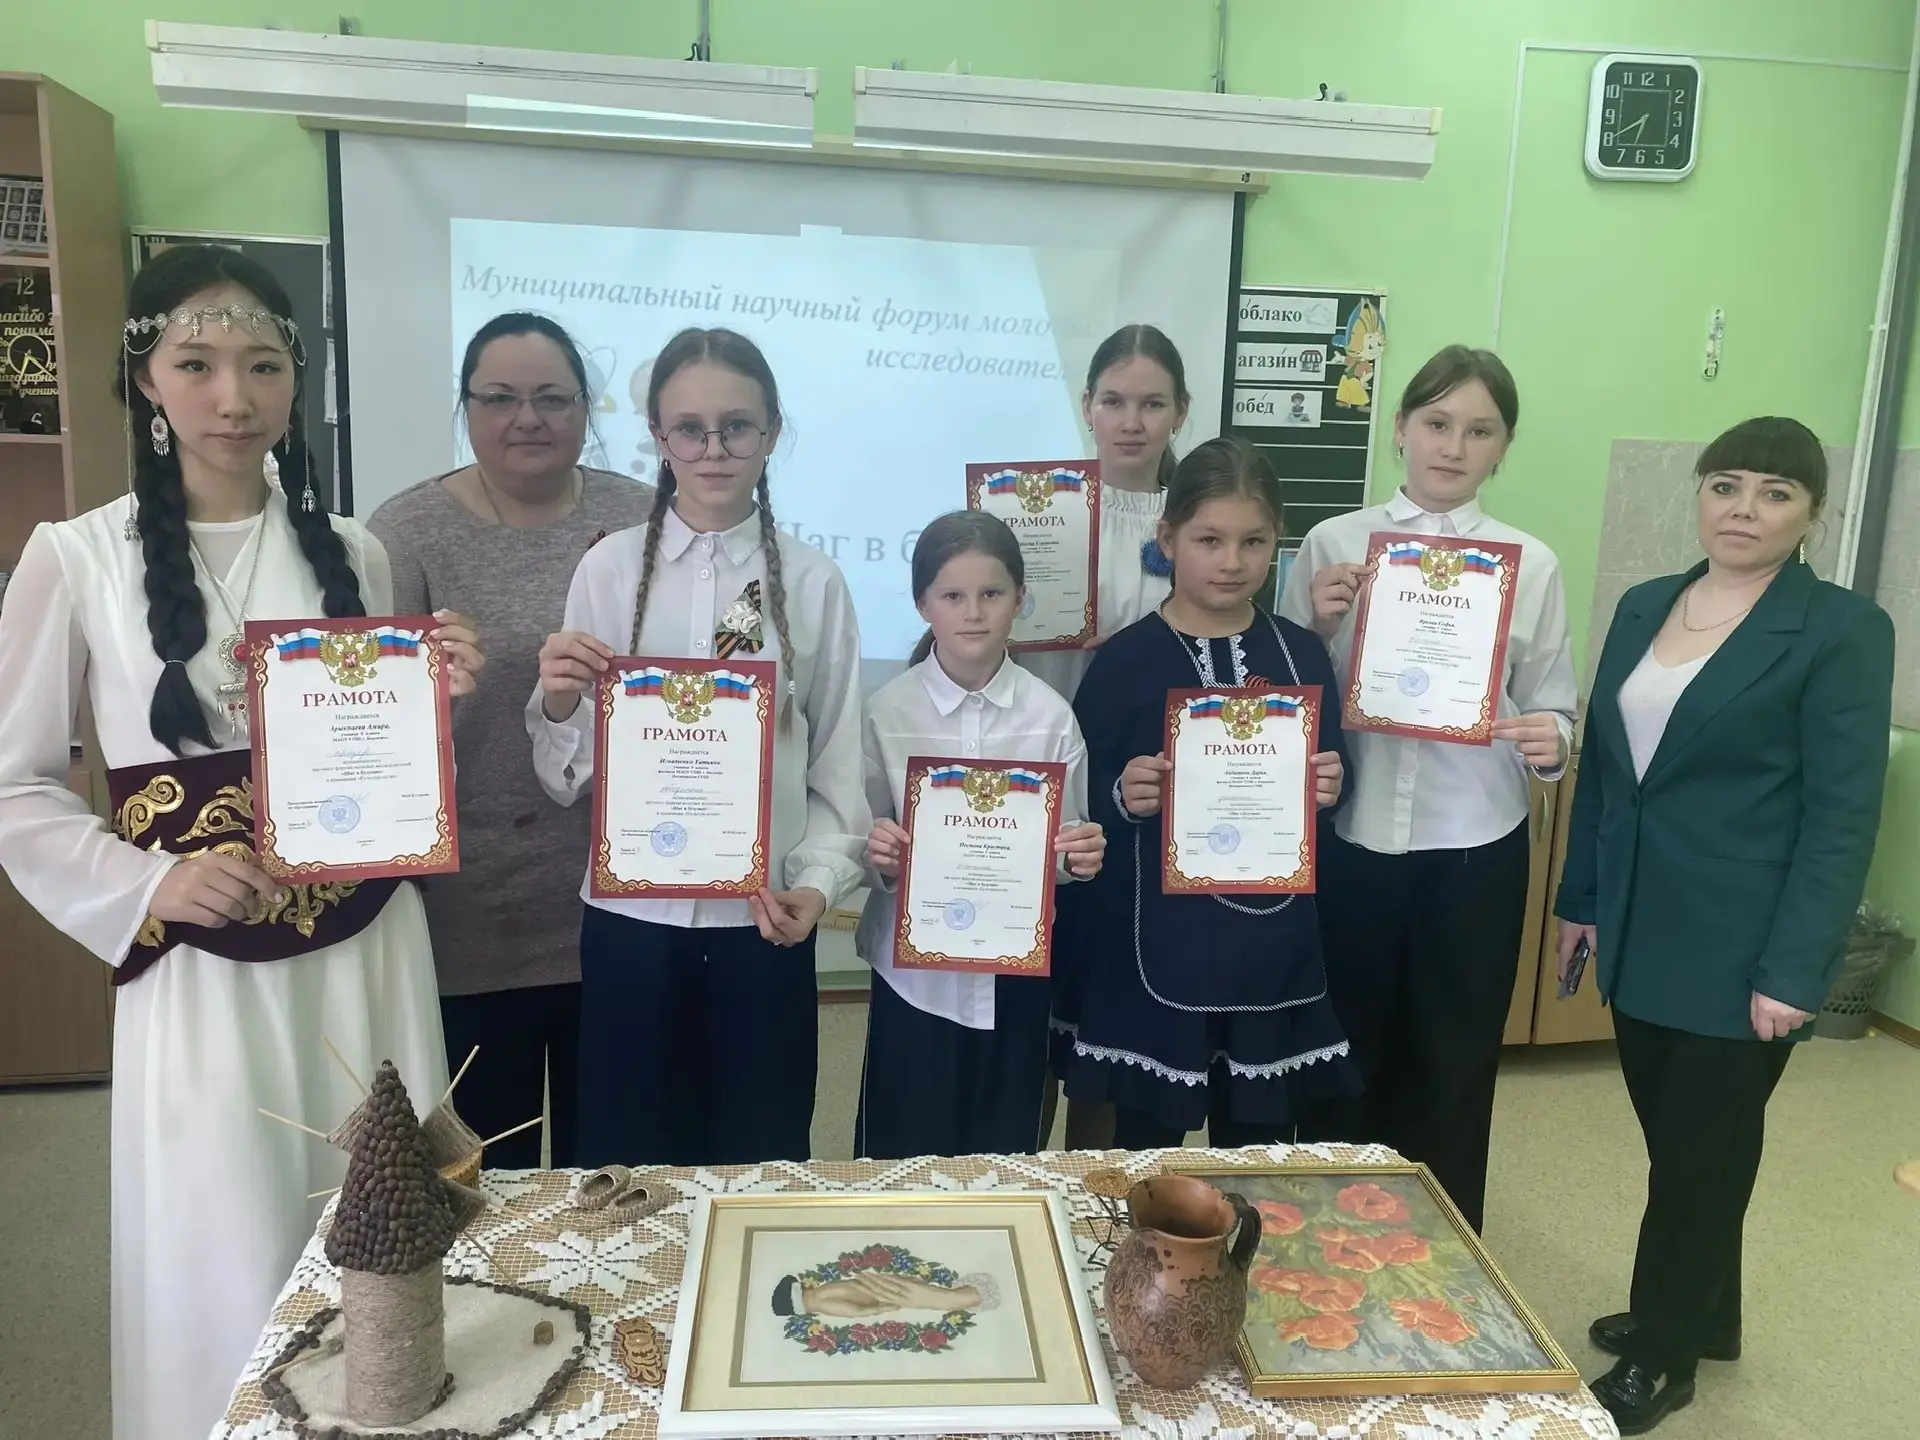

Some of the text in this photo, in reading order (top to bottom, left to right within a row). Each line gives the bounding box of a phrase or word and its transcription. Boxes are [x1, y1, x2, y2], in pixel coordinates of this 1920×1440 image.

[1623, 72, 1633, 85] 11
[1641, 72, 1655, 86] 12
[1666, 74, 1671, 86] 1
[1606, 84, 1620, 98] 10
[1675, 89, 1684, 104] 2
[1605, 108, 1615, 124] 9
[1672, 111, 1682, 127] 3
[1603, 132, 1614, 146] 8
[1670, 134, 1680, 148] 4
[1617, 148, 1626, 163] 7
[1636, 150, 1646, 164] 6
[1655, 150, 1664, 164] 5
[16, 277, 34, 295] 12
[461, 264, 723, 312] Муниципальный
[732, 293, 862, 323] научный
[873, 298, 969, 335] форум
[1003, 516, 1066, 528] ГРАМОТА
[864, 537, 885, 562] в
[1399, 591, 1471, 609] ГРАМОТА
[302, 690, 398, 707] ГРАМОТА
[642, 728, 728, 742] ГРАМОТА
[1204, 744, 1277, 756] ГРАМОТА
[944, 814, 1018, 830] ГРАМОТА
